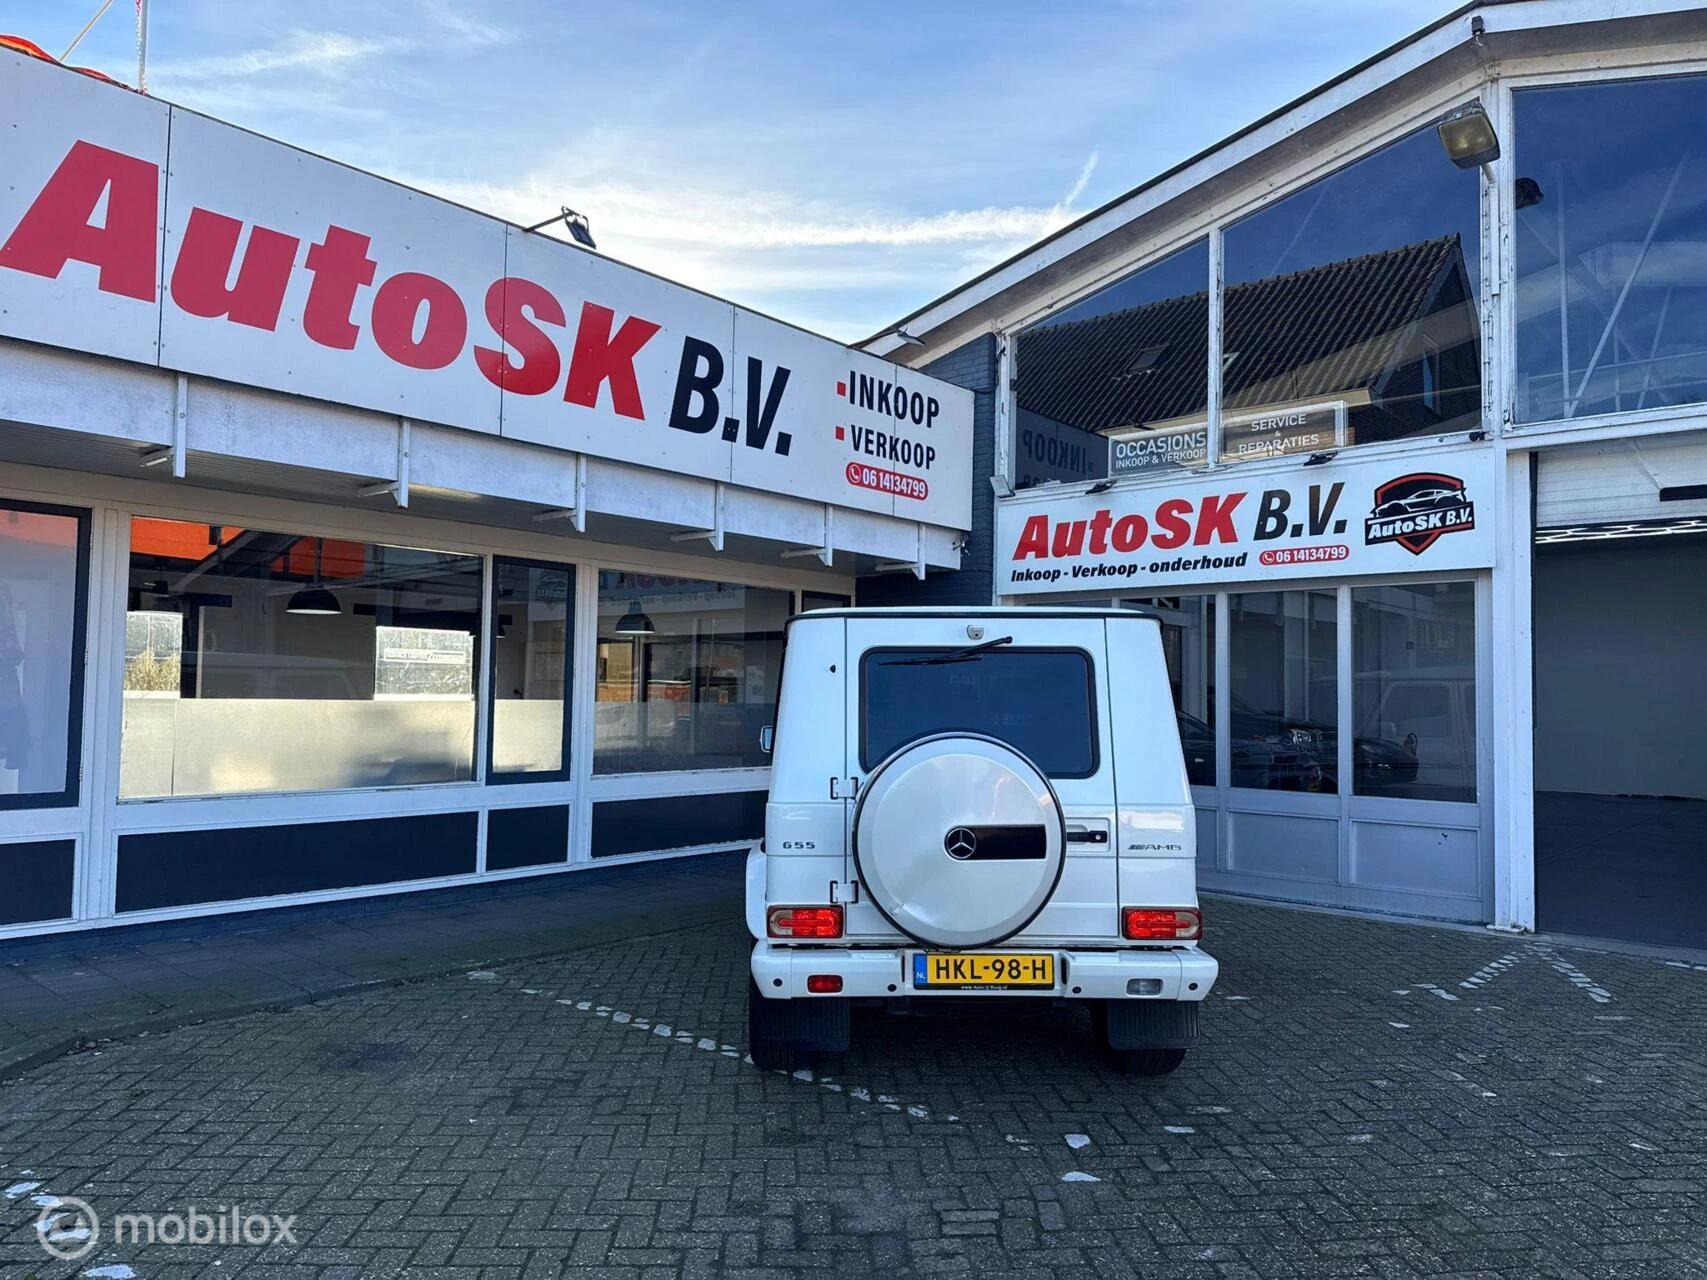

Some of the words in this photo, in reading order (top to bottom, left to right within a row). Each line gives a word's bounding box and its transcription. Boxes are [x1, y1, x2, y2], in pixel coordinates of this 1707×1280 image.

[0, 139, 663, 421] AutoSK
[668, 335, 792, 457] B.V.
[849, 370, 940, 428] INKOOP
[1251, 414, 1307, 432] SERVICE
[850, 424, 936, 470] VERKOOP
[1116, 431, 1207, 459] OCCASIONS
[1238, 433, 1320, 454] REPARATIES
[1115, 456, 1150, 469] INKOOP
[1151, 454, 1160, 464] &
[1161, 449, 1206, 463] VERKOOP
[862, 468, 877, 487] 06
[879, 472, 927, 499] 14134799
[1012, 491, 1248, 560] AutoSK
[1253, 482, 1348, 541] B.V.
[1367, 512, 1443, 540] AutoSK
[1445, 507, 1473, 526] B.V.
[1011, 568, 1061, 582] Inkoop
[1072, 563, 1138, 578] Verkoop
[1149, 552, 1249, 573] onderhoud
[1275, 551, 1291, 563] 06
[1293, 547, 1347, 561] 14134799
[935, 958, 1046, 980] HKL-98-H
